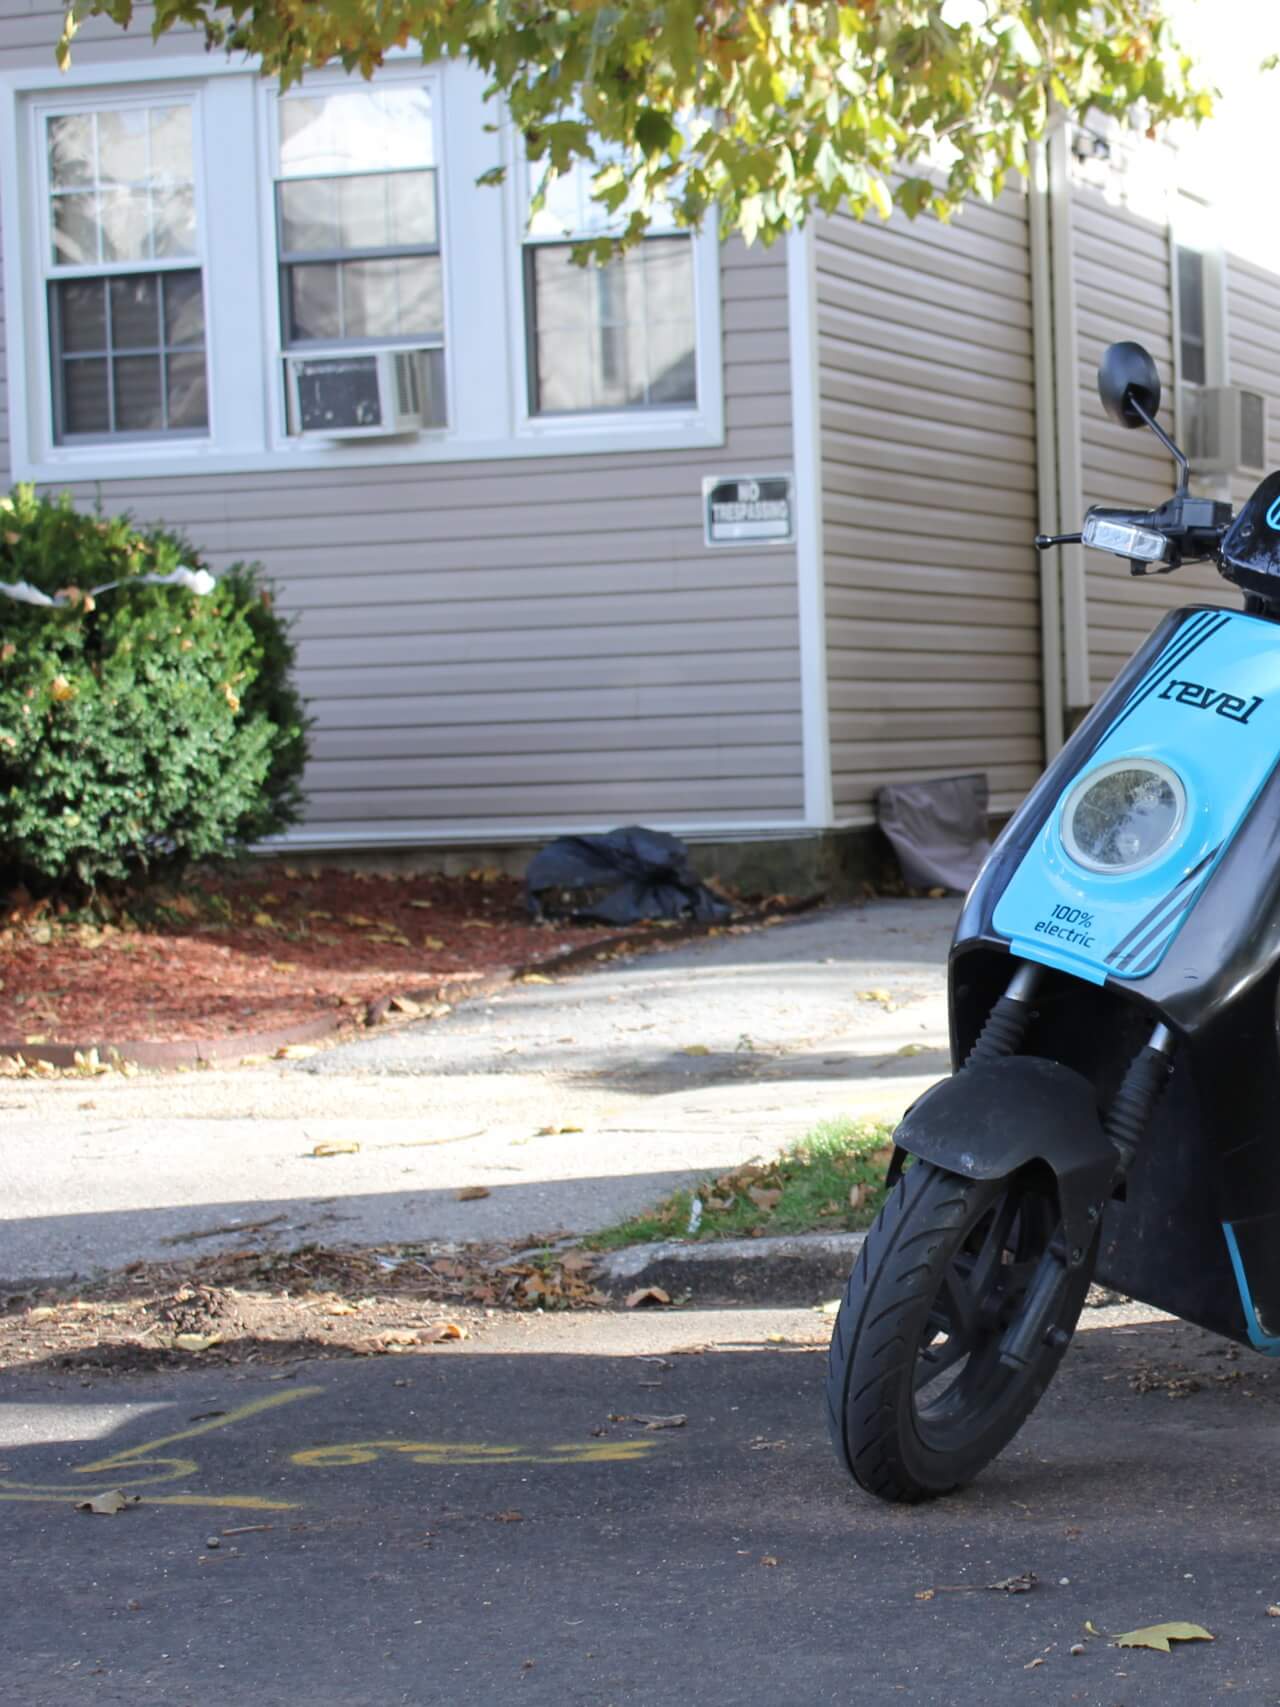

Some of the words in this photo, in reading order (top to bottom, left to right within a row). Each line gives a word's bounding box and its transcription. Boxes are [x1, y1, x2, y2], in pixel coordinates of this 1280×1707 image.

[737, 481, 761, 502] NO
[712, 498, 788, 521] TRESPASSING
[1157, 679, 1264, 725] revel
[1050, 904, 1094, 928] 100%
[1034, 920, 1096, 948] electric
